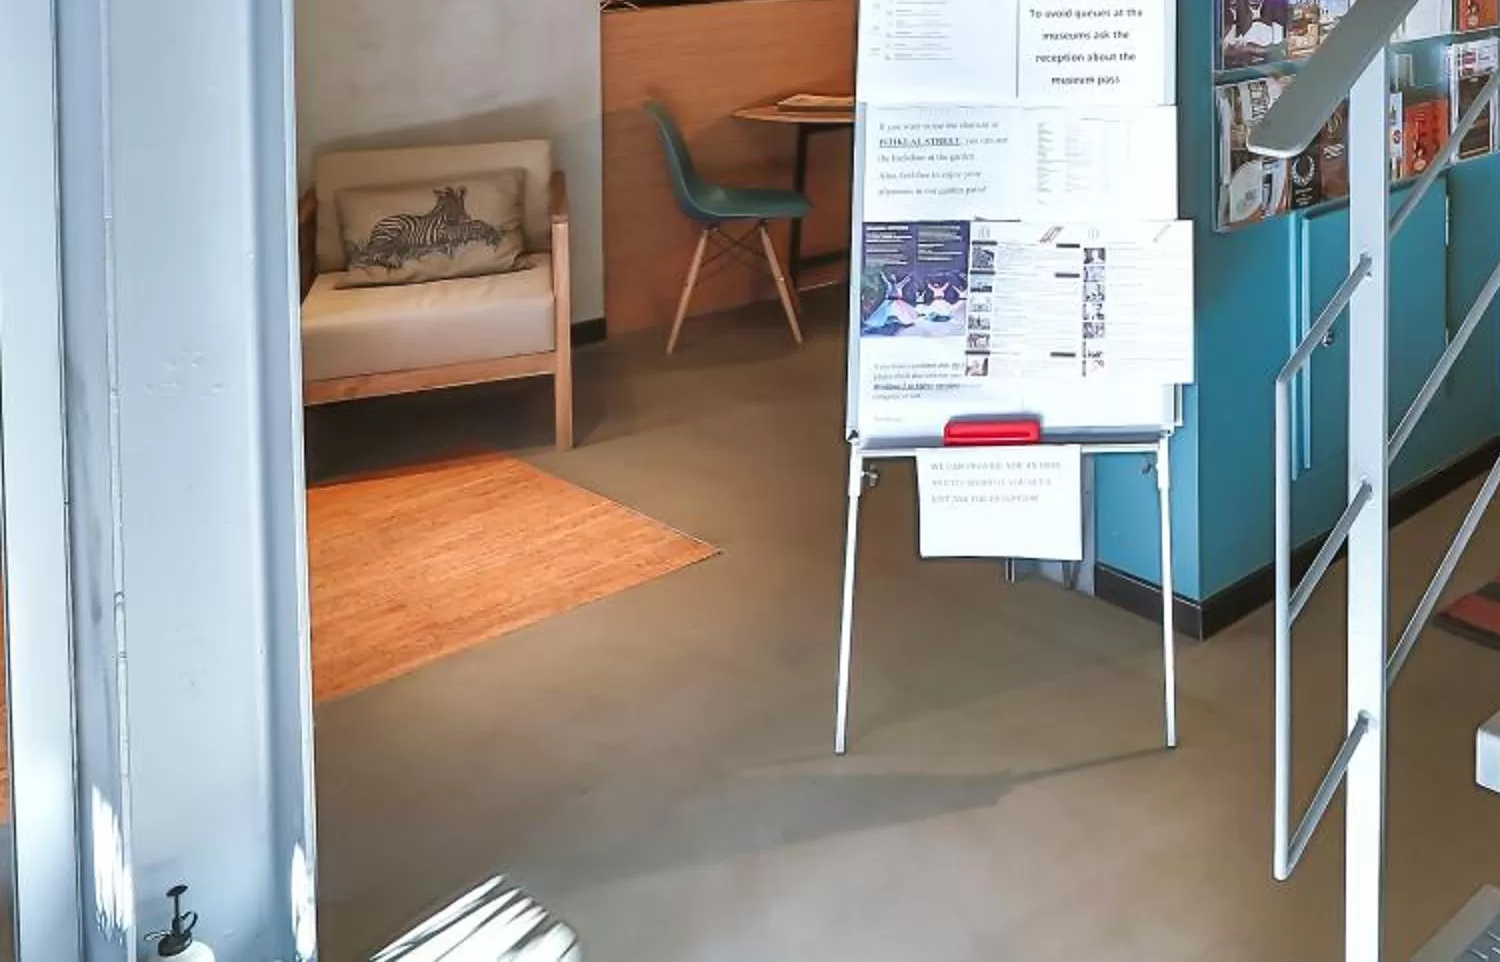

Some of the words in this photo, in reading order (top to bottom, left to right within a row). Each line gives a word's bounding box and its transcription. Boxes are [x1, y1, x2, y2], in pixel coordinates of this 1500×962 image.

[1113, 30, 1130, 39] the
[1035, 52, 1084, 64] reception
[1087, 52, 1116, 62] about
[1119, 52, 1136, 61] the
